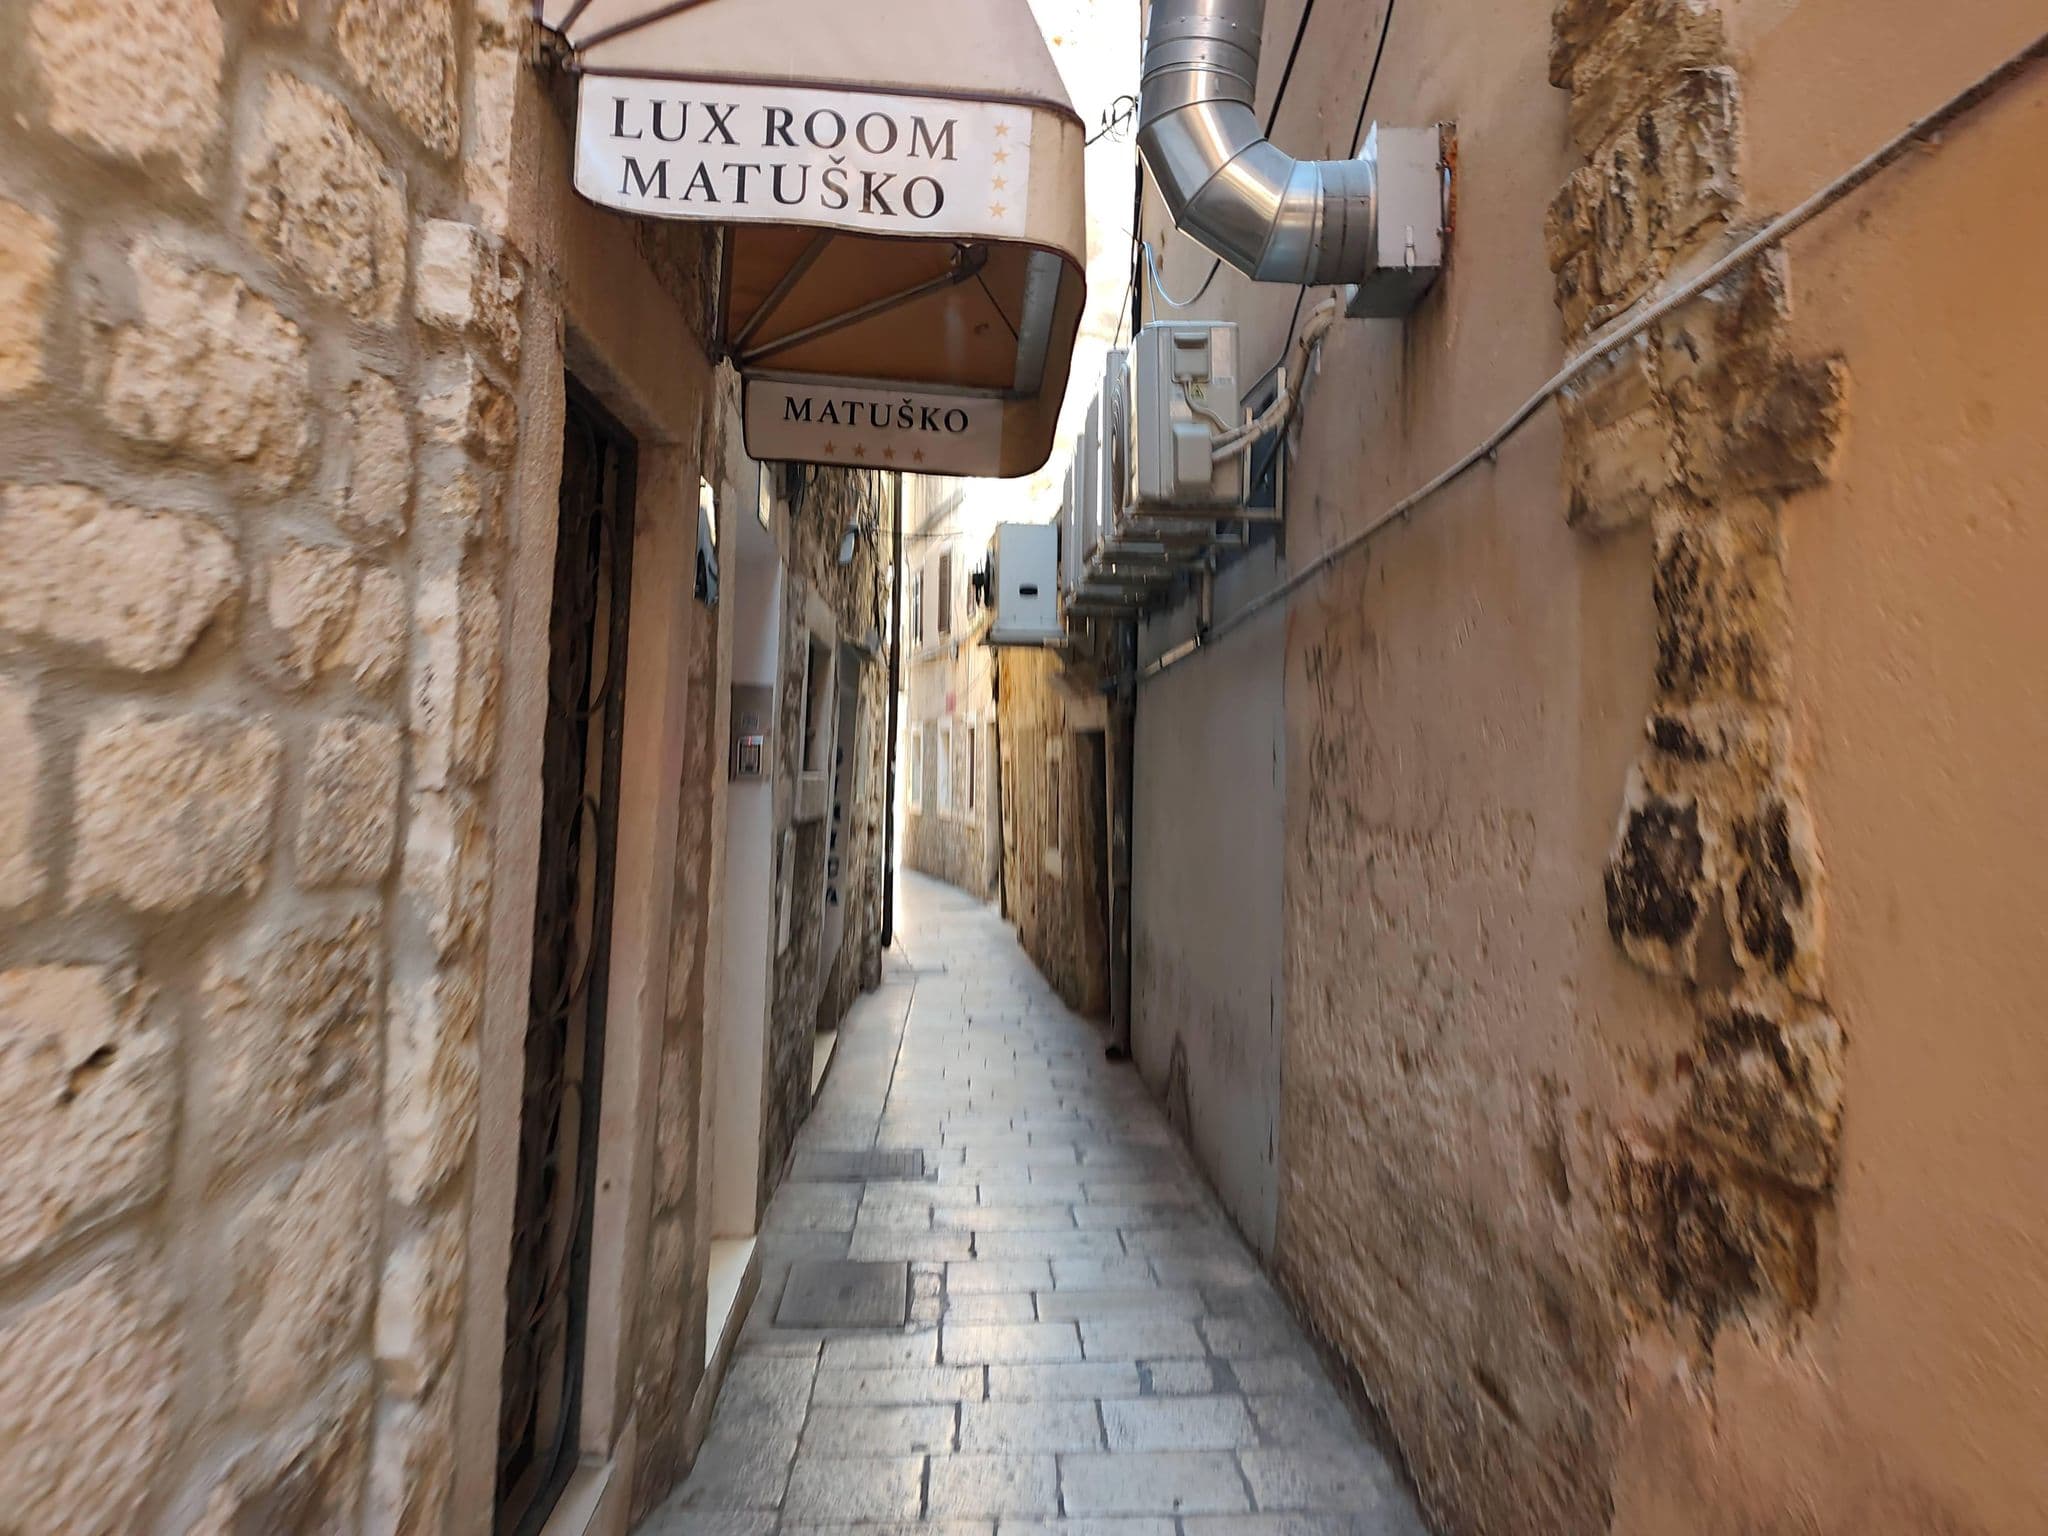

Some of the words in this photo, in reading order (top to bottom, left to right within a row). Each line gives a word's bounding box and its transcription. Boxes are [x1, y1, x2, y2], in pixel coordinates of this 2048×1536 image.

[609, 97, 741, 145] LUX
[761, 105, 958, 162] ROOM
[618, 154, 945, 219] MATUŠKO
[783, 395, 969, 433] MATUŠKO
